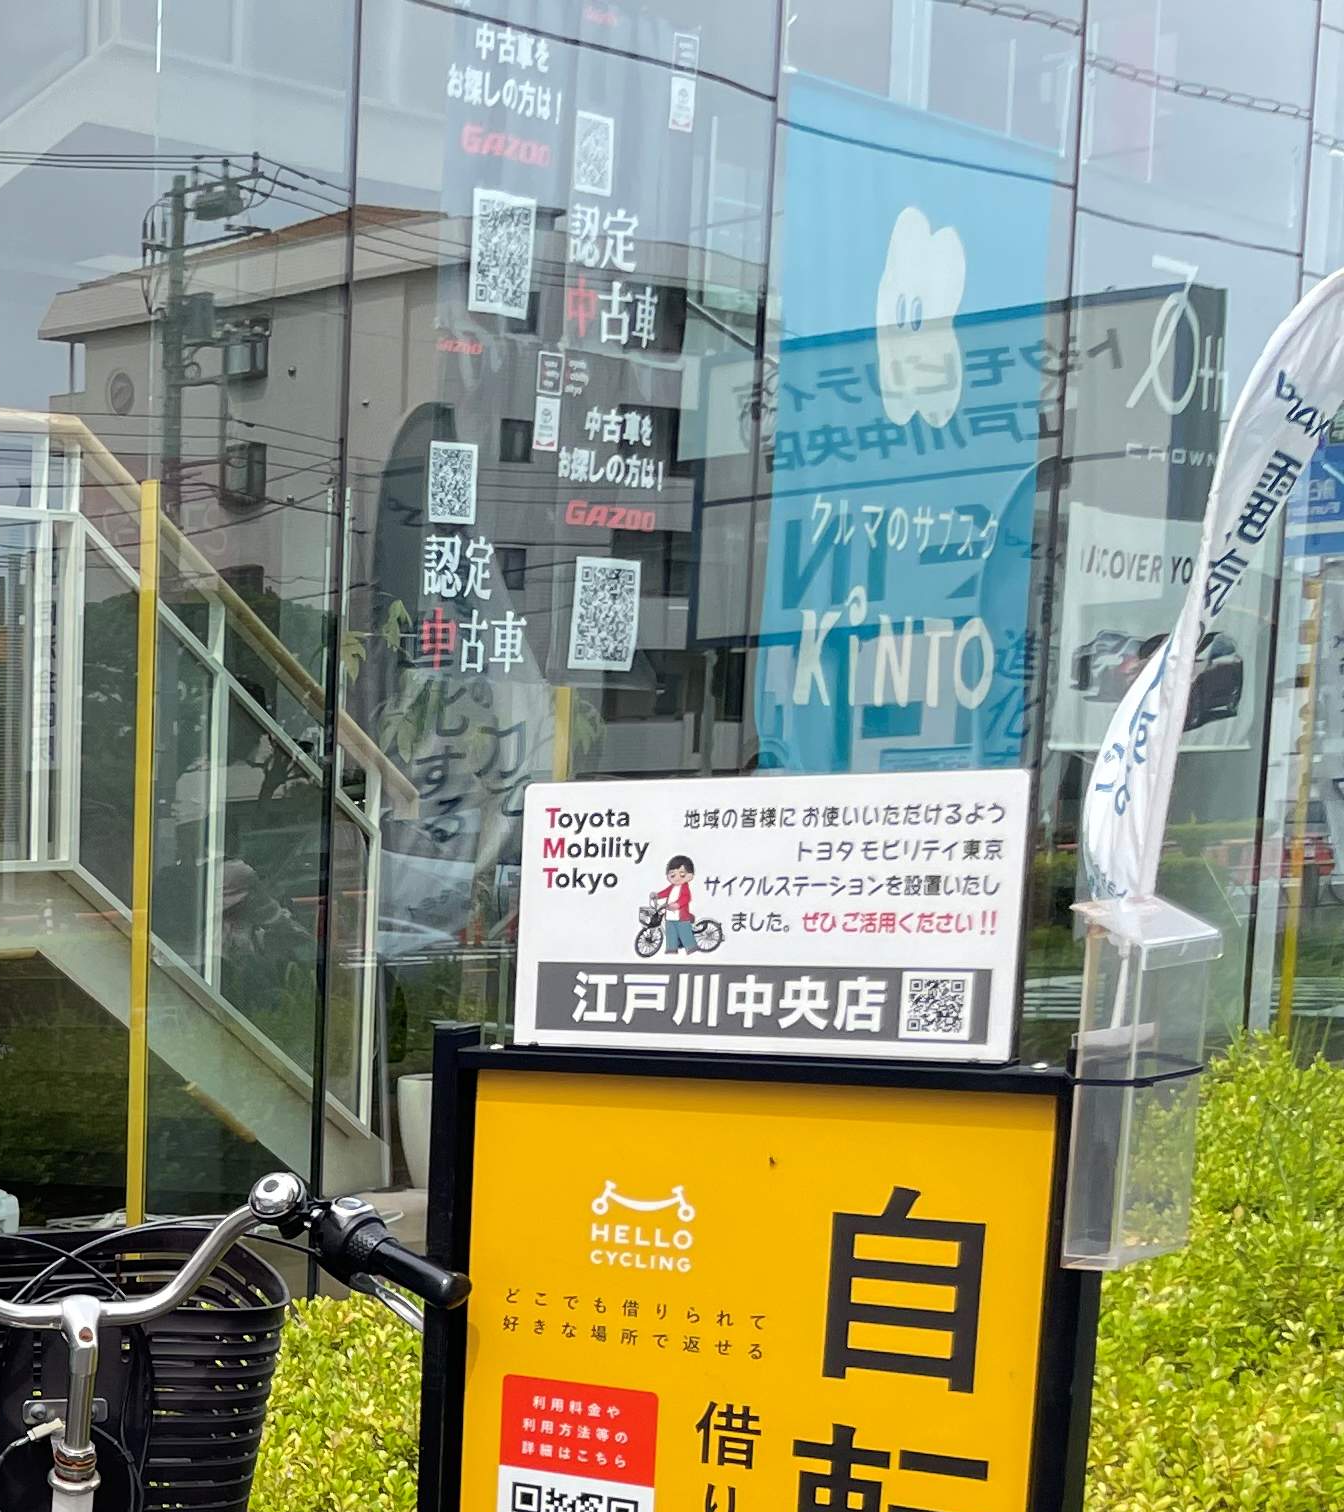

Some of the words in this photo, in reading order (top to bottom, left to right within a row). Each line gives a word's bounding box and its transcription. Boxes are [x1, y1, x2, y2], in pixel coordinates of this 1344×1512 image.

[568, 203, 639, 273] 認定
[567, 272, 658, 349] 中古車
[584, 406, 652, 447] 中古車を
[565, 499, 657, 533] GAZOO
[423, 535, 495, 600] 認定
[421, 607, 527, 674] 中古車
[545, 806, 630, 833] Toyota
[684, 803, 1006, 830] 地域の皆様にお使いいただけるよう
[543, 837, 649, 864] Mobility
[543, 867, 618, 894] Tokyo
[704, 874, 1000, 898] サイクルステーションを設置いたし
[572, 970, 886, 1033] 江戸川中央店
[591, 1223, 693, 1251] HELLO
[590, 1249, 693, 1273] CYCLING
[505, 1288, 766, 1330] どこでも借りられて
[503, 1315, 764, 1360] 好きな場所で返せる
[532, 1395, 620, 1418] 利用料金や
[522, 1417, 628, 1444] 利用方法等の
[521, 1441, 626, 1469] 詳細はこちら
